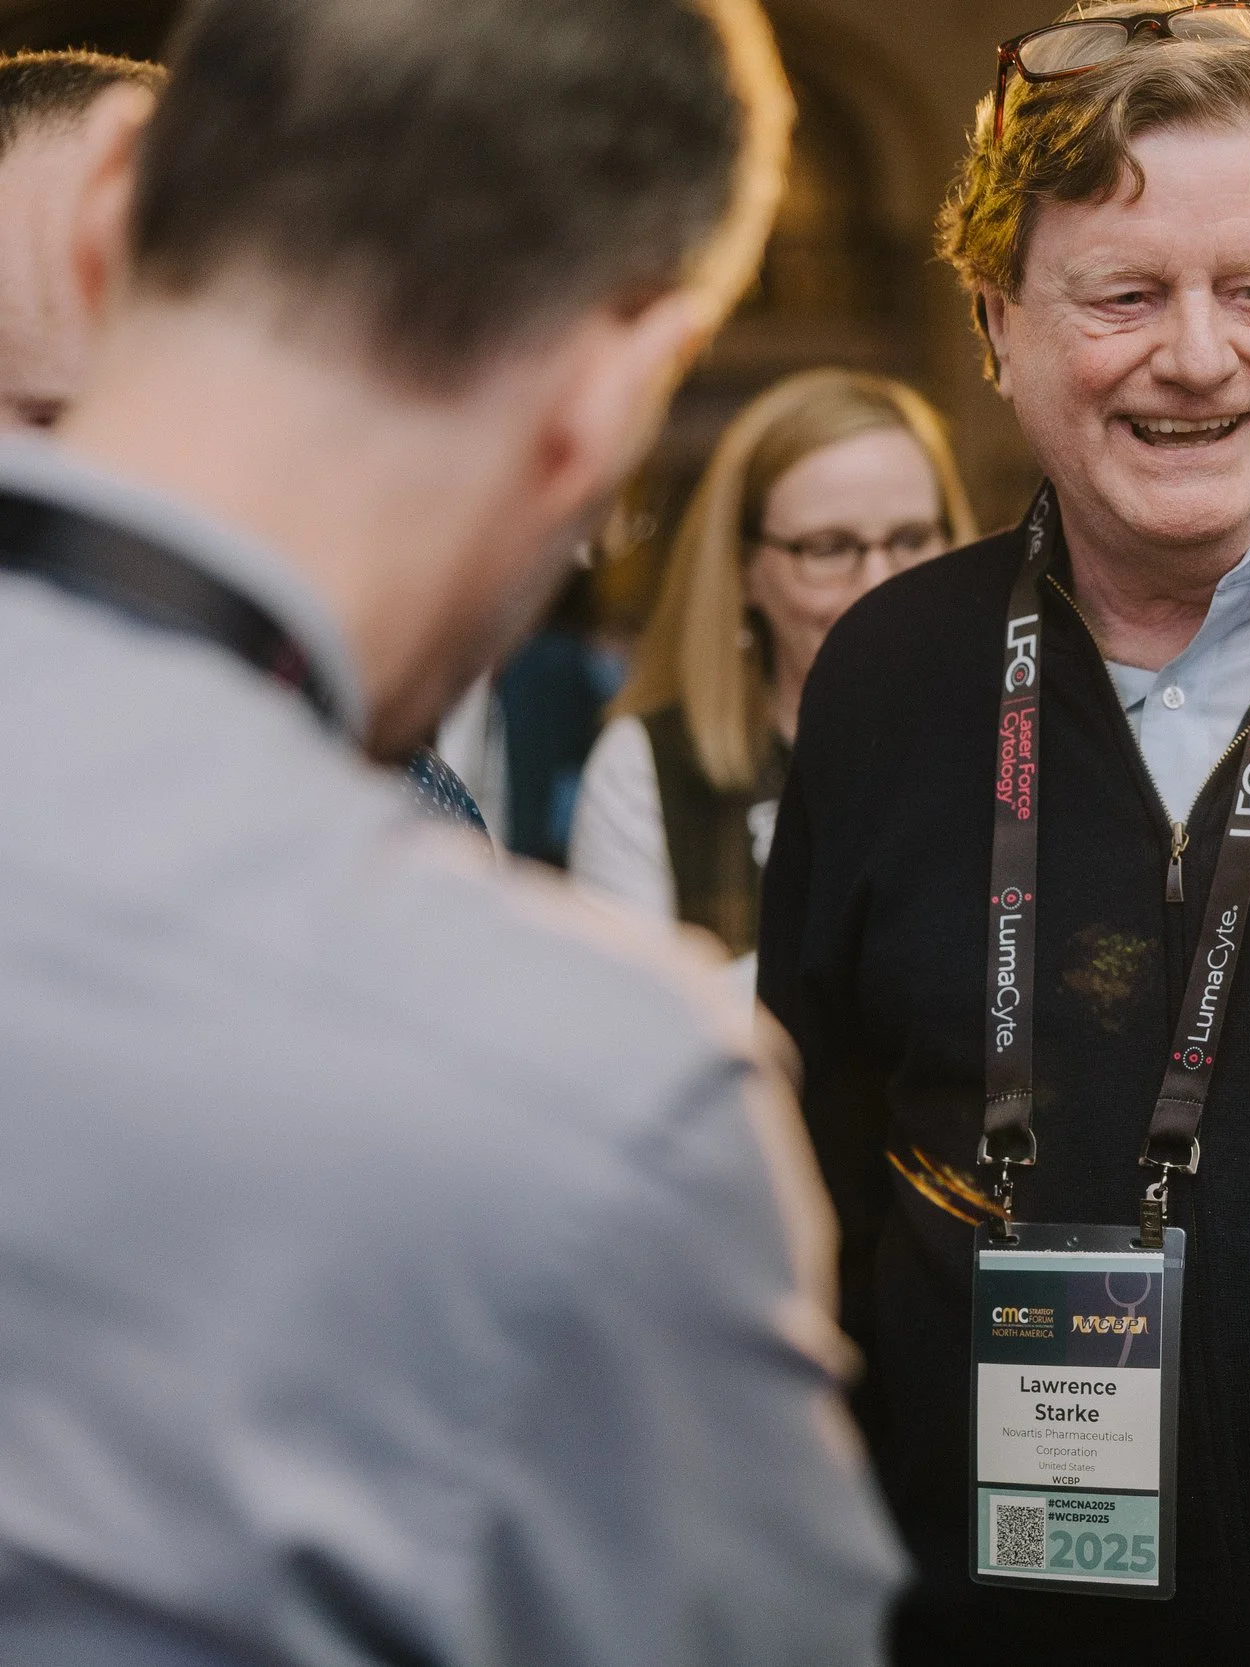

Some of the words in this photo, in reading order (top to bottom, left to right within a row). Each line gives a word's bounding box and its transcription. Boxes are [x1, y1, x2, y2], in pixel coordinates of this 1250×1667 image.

[1005, 613, 1039, 693] LFC
[1019, 707, 1036, 759] Laser
[1017, 763, 1035, 820] Force
[1029, 1315, 1055, 1324] FORUM
[992, 1329, 1018, 1338] NORTH
[1019, 1330, 1055, 1339] AMERICA
[1020, 1376, 1117, 1396] Lawrence
[1035, 1403, 1100, 1423] Starke
[1002, 1427, 1043, 1439] Novartis
[1045, 1429, 1134, 1442] Pharmaceuticals
[1036, 1445, 1098, 1459] Corporation
[1038, 1462, 1067, 1471] United
[1069, 1463, 1096, 1472] States
[1052, 1476, 1080, 1485] WCBP
[1048, 1499, 1116, 1511] #CMCNA2025
[1048, 1514, 1110, 1524] #WCBP2025
[1049, 1530, 1157, 1573] 2025
